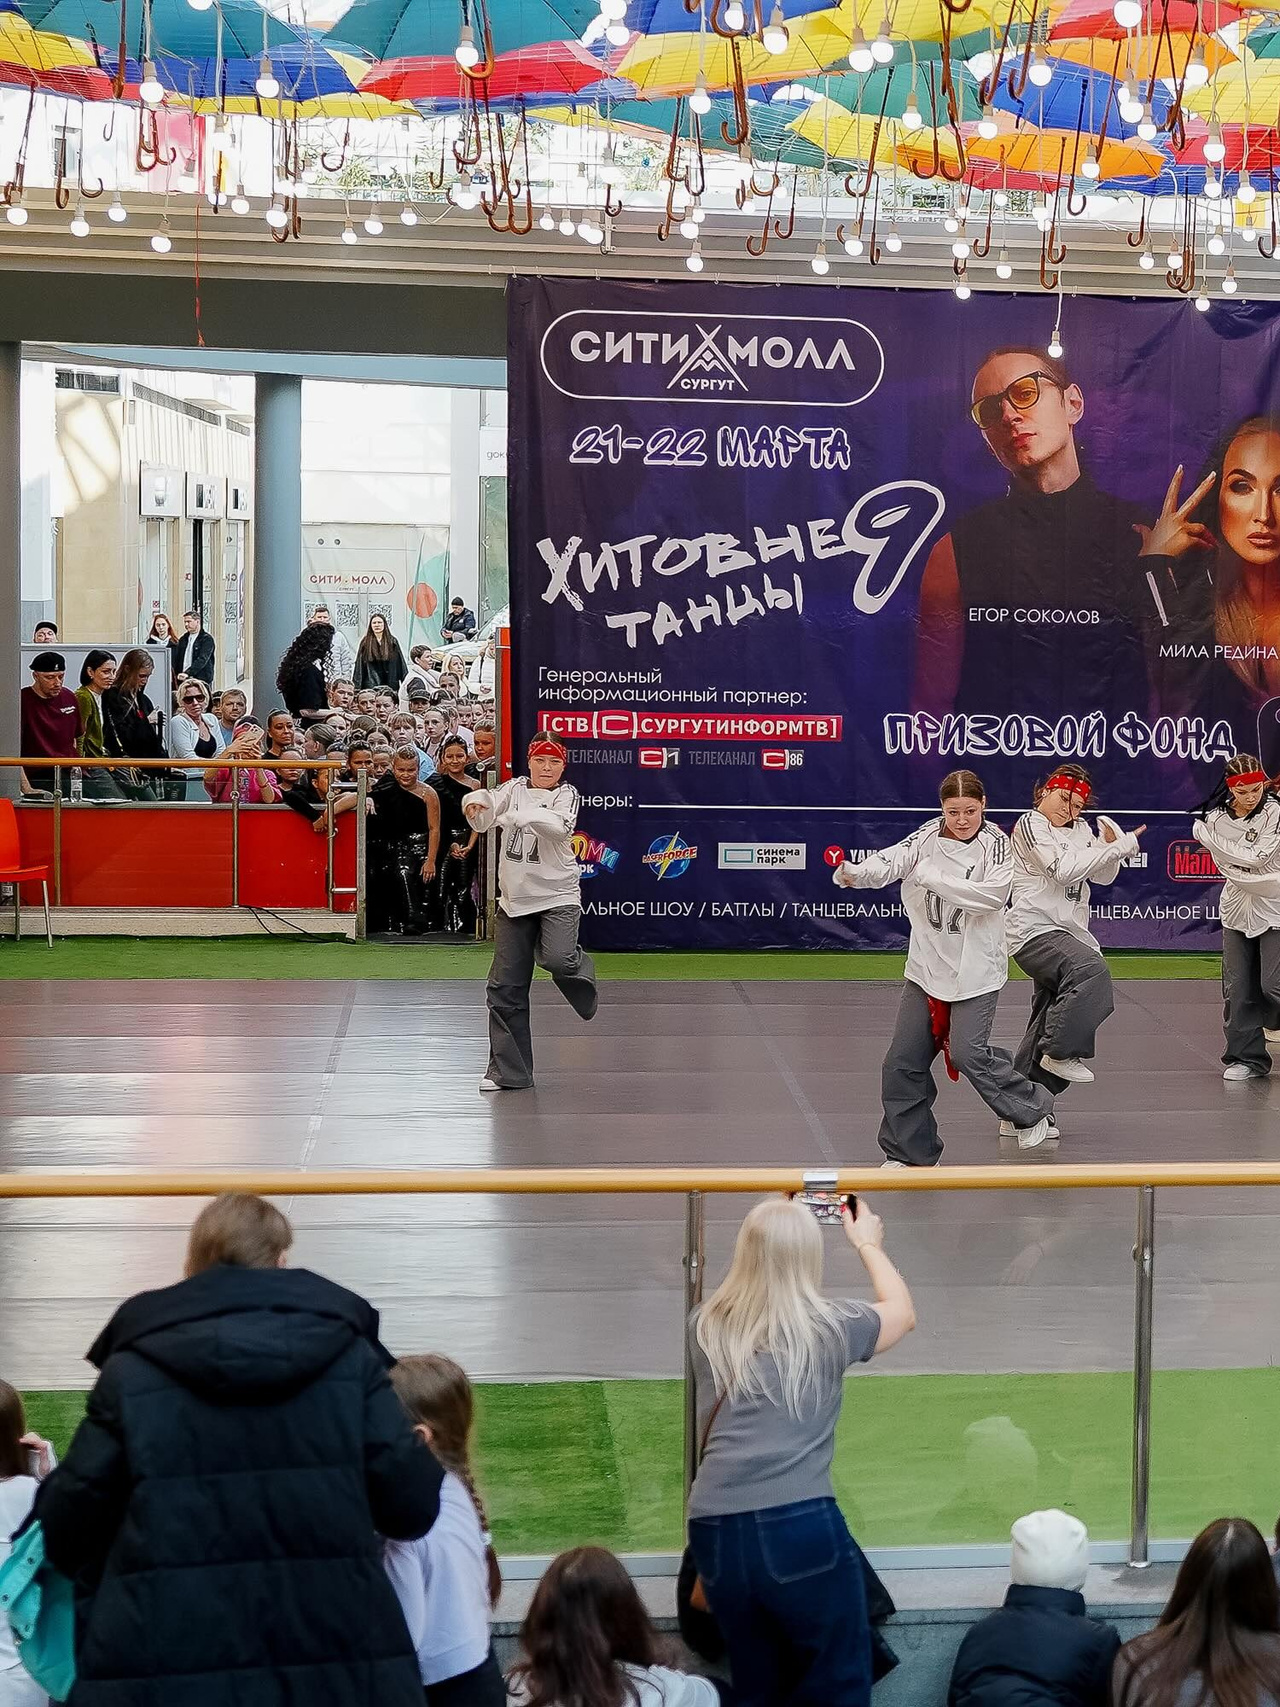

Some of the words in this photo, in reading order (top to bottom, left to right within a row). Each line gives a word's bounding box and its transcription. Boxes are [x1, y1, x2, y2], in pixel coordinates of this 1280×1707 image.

[569, 330, 688, 365] СИТИ
[728, 334, 855, 371] МОЛЛ
[681, 378, 735, 392] СУРГУТ
[569, 424, 706, 466] 21-22
[717, 427, 851, 470] МАРТА
[310, 575, 342, 584] СИТИ
[352, 576, 387, 584] МОЛЛ
[606, 573, 805, 648] ТАНЦЫ
[969, 608, 1009, 622] ЕГОР
[1014, 608, 1100, 624] СОКОЛОВ
[1159, 645, 1209, 659] МИЛА
[1214, 645, 1279, 660] РЕДИНА
[538, 666, 662, 685] Генеральный
[538, 687, 718, 704] информационный
[723, 690, 808, 706] партнер:
[883, 711, 1107, 758] ПРИЗОВОЙ
[1113, 711, 1237, 763] ФОНД
[566, 749, 633, 765] ТЕЛЕКАНАЛ
[689, 750, 756, 766] ТЕЛЕКАНАЛ
[580, 795, 633, 811] неры:
[642, 846, 698, 864] LASERFORCE
[757, 848, 800, 856] синема
[757, 856, 786, 866] парк
[650, 902, 694, 917] ШОУ
[711, 902, 774, 917] БАТТЛЫ
[1090, 905, 1200, 920] НЦЕВАЛЬНОЕ
